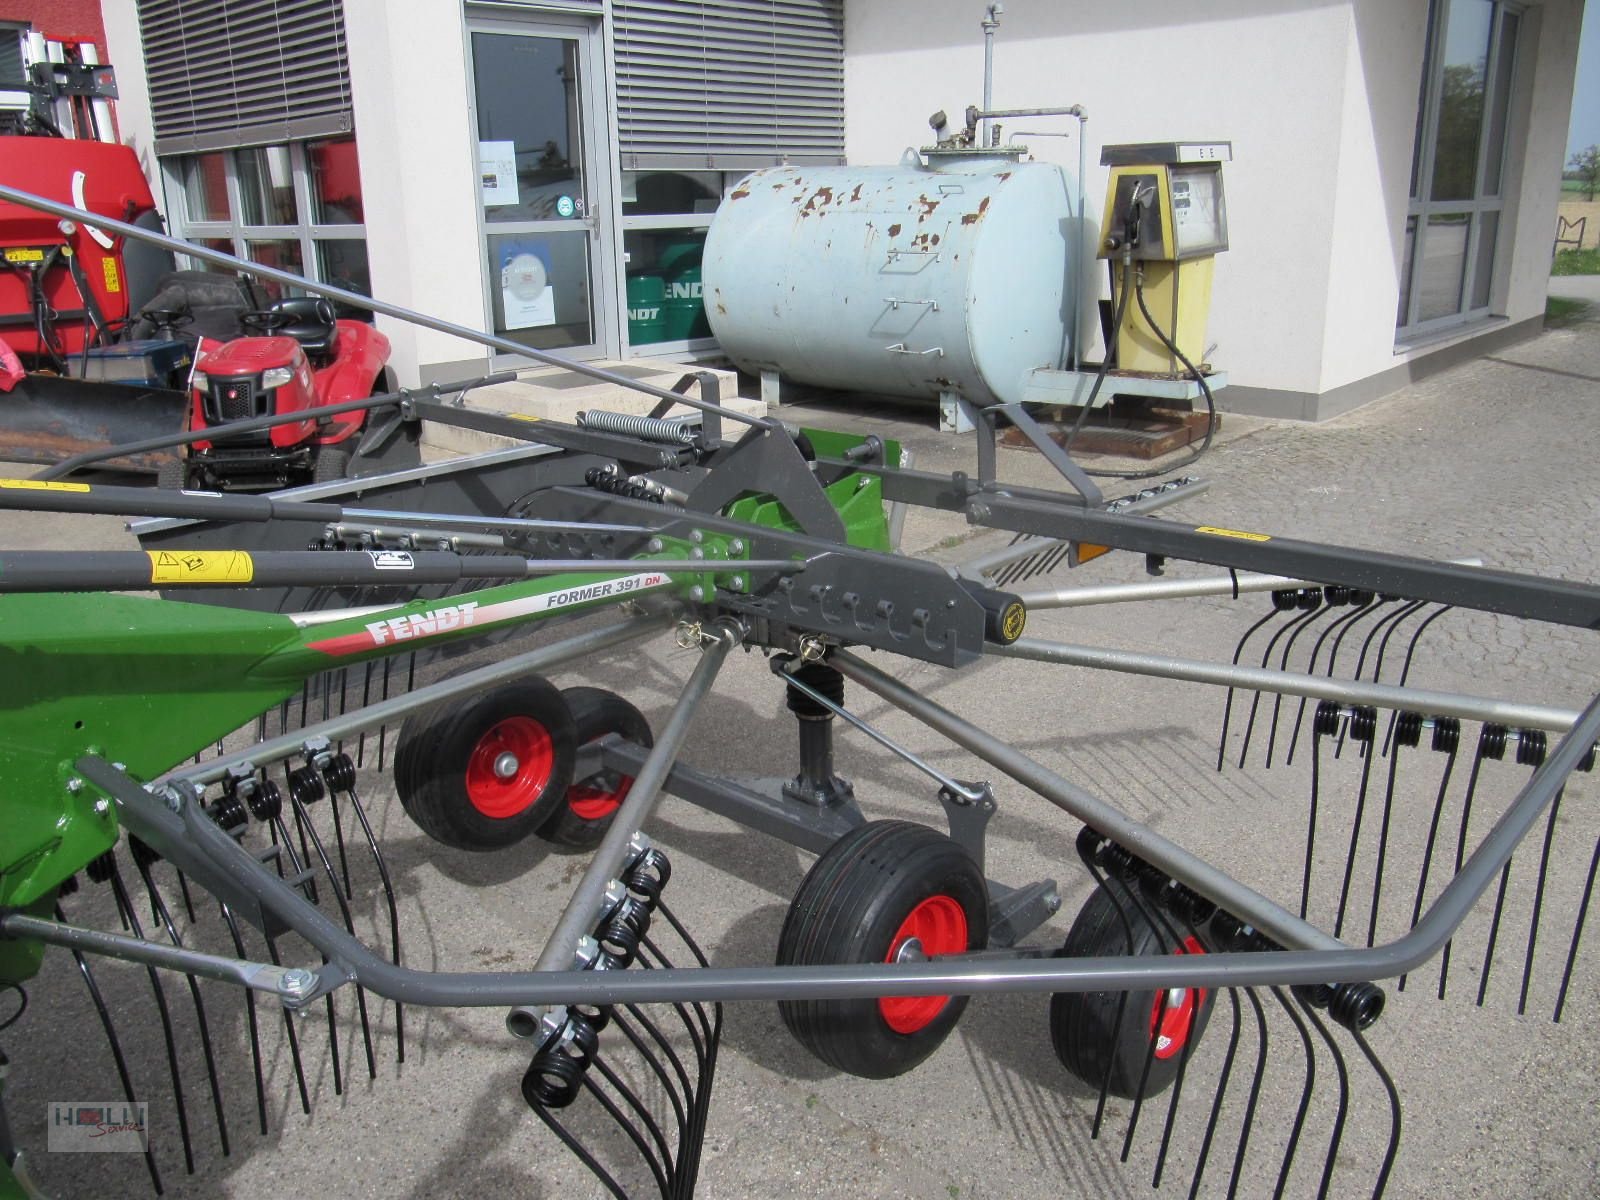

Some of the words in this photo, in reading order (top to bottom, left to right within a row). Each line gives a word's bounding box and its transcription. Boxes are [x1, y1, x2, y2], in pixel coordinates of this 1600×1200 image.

[627, 307, 660, 320] NDT
[547, 584, 612, 608] FORMER
[615, 578, 641, 593] 391
[644, 575, 661, 587] DN
[365, 601, 478, 644] FENDT
